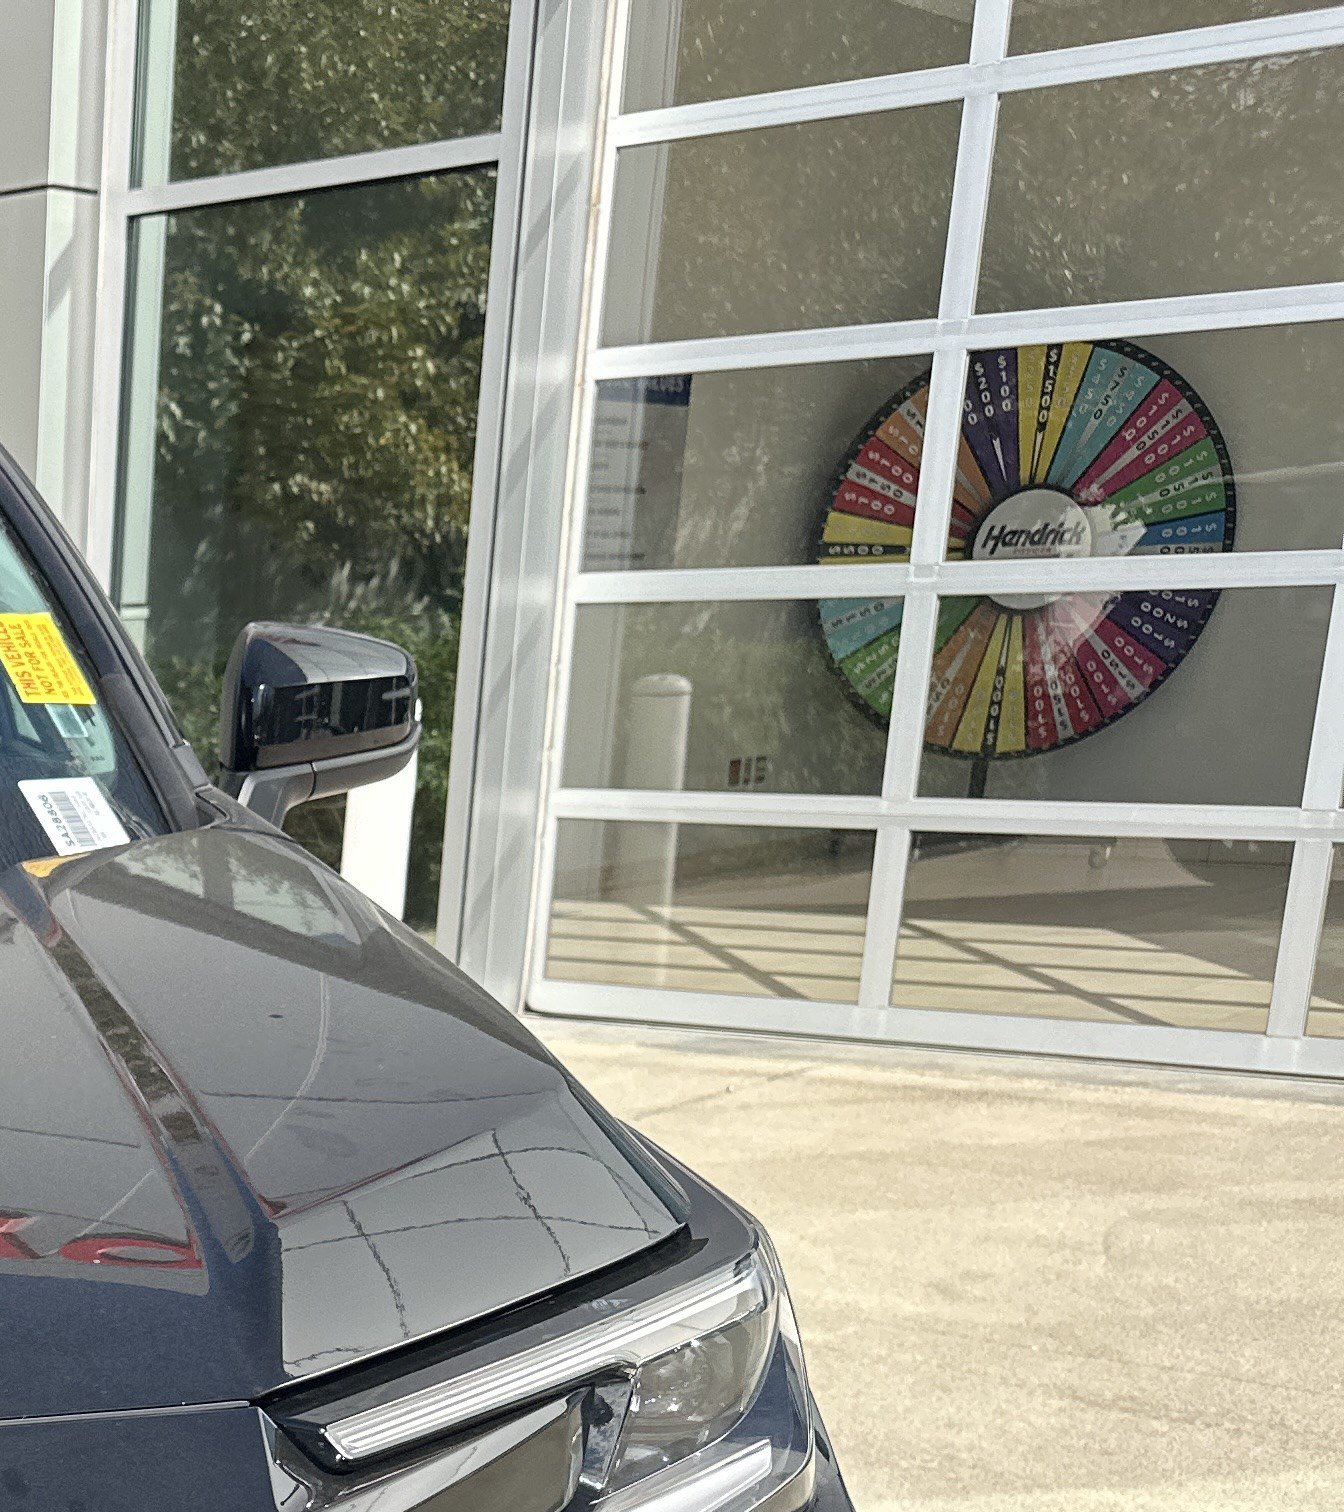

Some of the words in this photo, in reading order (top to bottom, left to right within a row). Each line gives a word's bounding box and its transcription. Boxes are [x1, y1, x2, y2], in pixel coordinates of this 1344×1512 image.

[997, 355, 1011, 412] $100
[1039, 349, 1057, 423] $1500
[982, 521, 1086, 555] Hendrick
[8, 623, 31, 647] SALE
[24, 651, 42, 671] FOR
[15, 671, 40, 697] THIS
[36, 674, 56, 695] NOT
